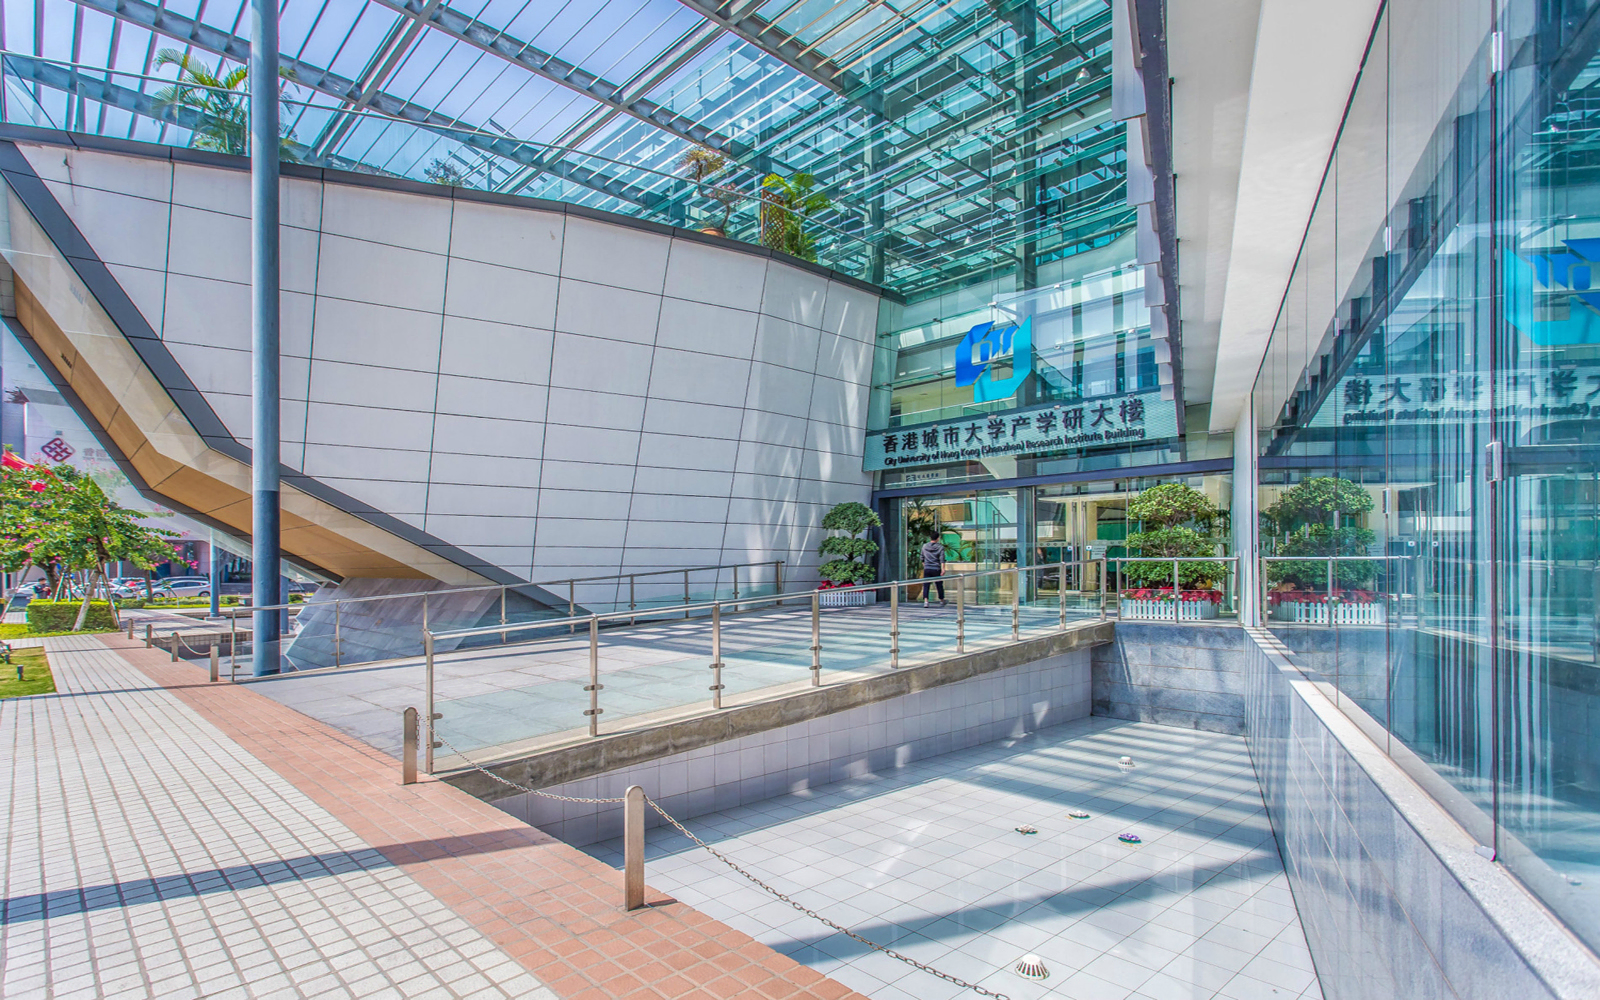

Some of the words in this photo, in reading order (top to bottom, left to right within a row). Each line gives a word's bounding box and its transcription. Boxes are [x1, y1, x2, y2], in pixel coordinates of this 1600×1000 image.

[883, 399, 1144, 453] 香港城市大学产学研大楼
[884, 456, 897, 466] City
[898, 453, 931, 464] University
[940, 450, 960, 460] Hong
[960, 447, 980, 458] Kong
[981, 440, 1024, 456] (Shenzhen)
[1025, 435, 1063, 449] Research
[1064, 431, 1102, 445] Institute
[1104, 426, 1145, 439] Building
